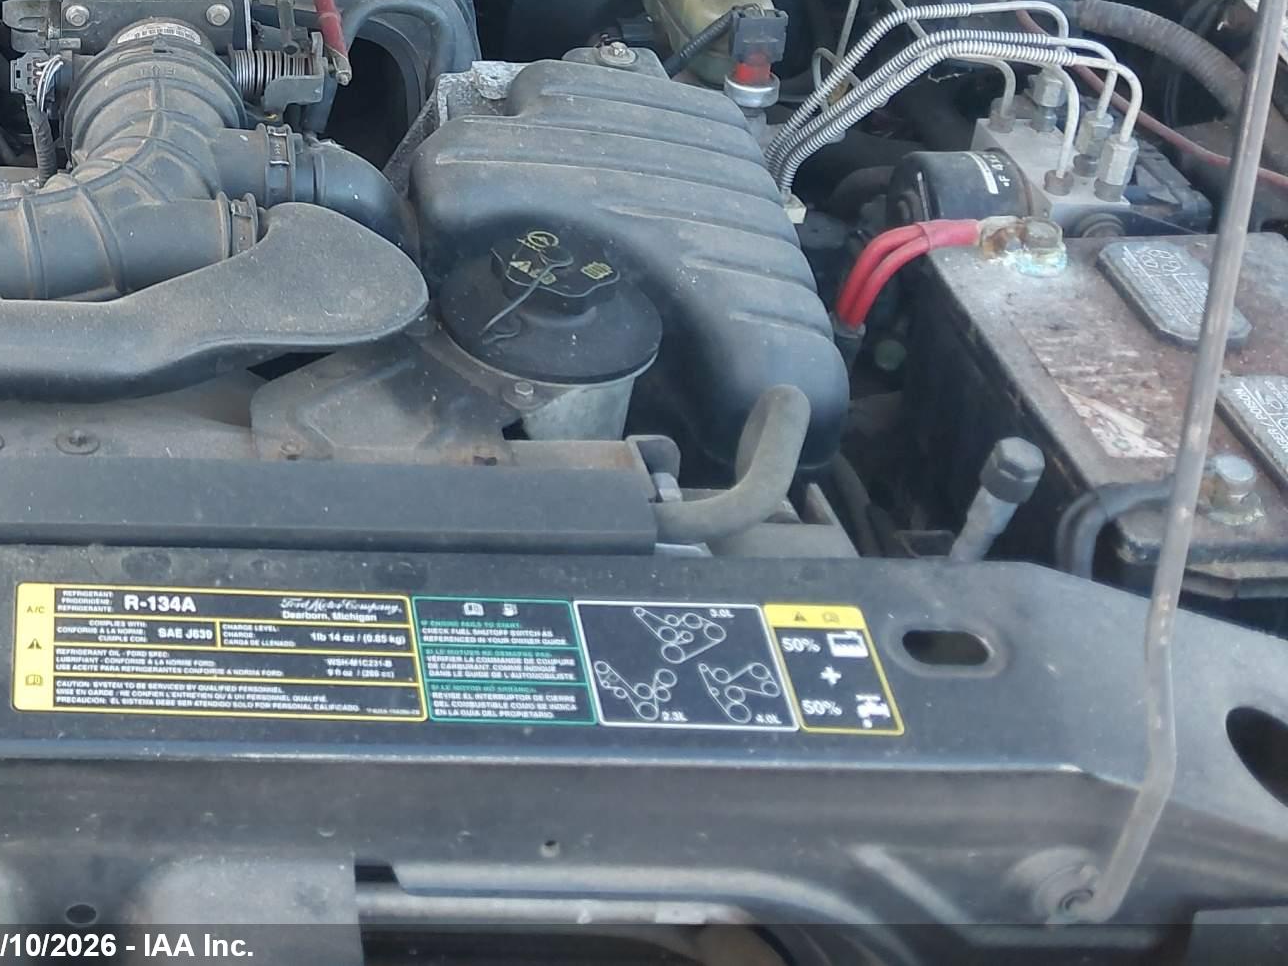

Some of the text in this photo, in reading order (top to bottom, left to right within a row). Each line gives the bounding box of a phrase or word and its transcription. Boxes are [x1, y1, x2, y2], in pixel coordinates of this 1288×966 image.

[1232, 387, 1268, 420] POISON
[123, 594, 197, 612] R-134A
[280, 597, 309, 609] Ford
[306, 598, 342, 611] Motor
[27, 605, 45, 614] A/C
[282, 611, 378, 622] Dearborn, Michigan
[157, 627, 213, 640] SAE J639
[328, 633, 341, 642] 14
[342, 634, 355, 642] oz
[388, 634, 406, 645] kg)
[423, 635, 476, 643] REFERENCED
[781, 637, 821, 653] 50%
[56, 648, 108, 656] REFRIGERANT
[476, 656, 522, 664] COMMANDE
[56, 688, 74, 696] MISE
[93, 681, 124, 689] SYSTEM
[148, 683, 185, 691] SERVICED
[198, 684, 237, 692] QUALIFIED
[432, 691, 461, 699] REVISE
[156, 699, 175, 707] DEBE
[272, 702, 312, 710] PERSONAL
[801, 699, 843, 716] 50%
[662, 712, 688, 722] 2.3L
[755, 714, 782, 724] 4.0L
